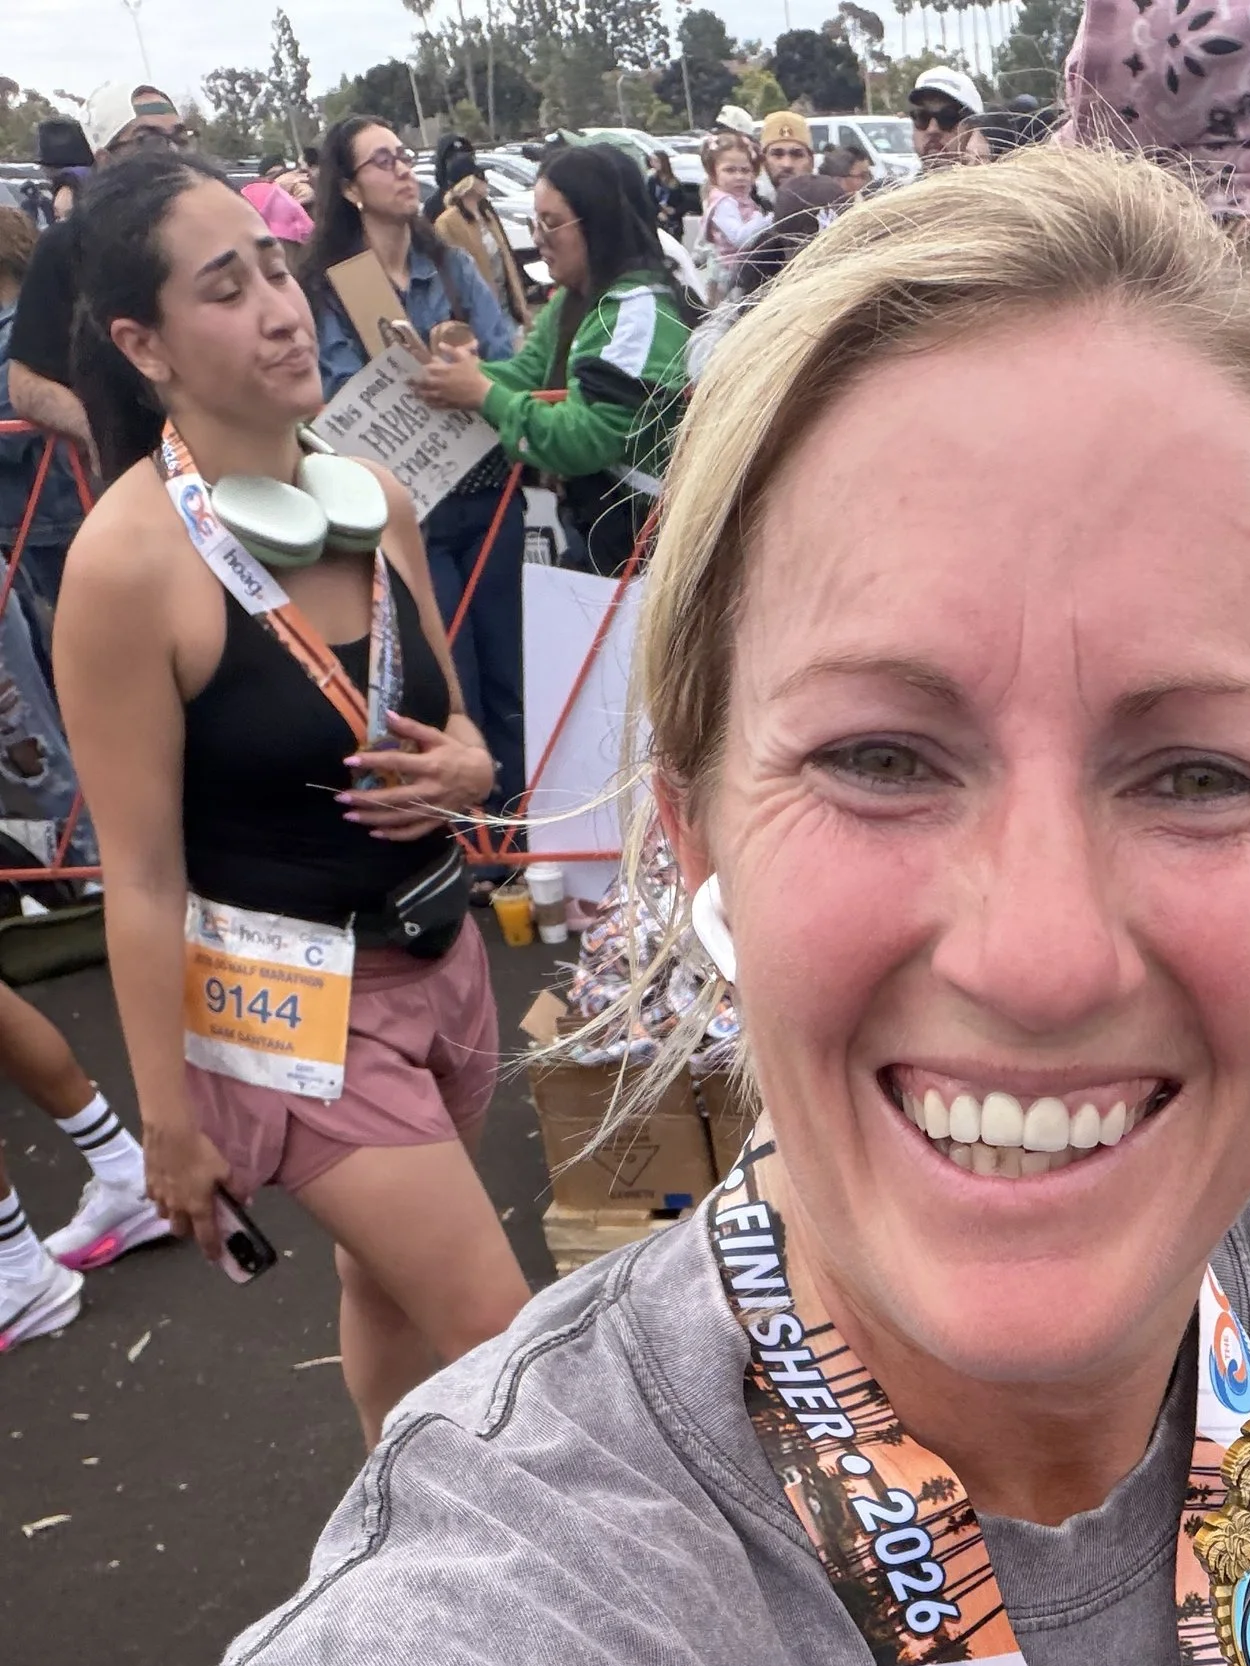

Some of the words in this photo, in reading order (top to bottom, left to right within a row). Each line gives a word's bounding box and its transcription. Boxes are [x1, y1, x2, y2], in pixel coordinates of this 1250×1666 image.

[259, 965, 326, 990] MARATHON
[304, 945, 325, 967] C
[204, 975, 303, 1030] 9144
[715, 1201, 857, 1442] FINISHER
[852, 1488, 961, 1634] 2026
